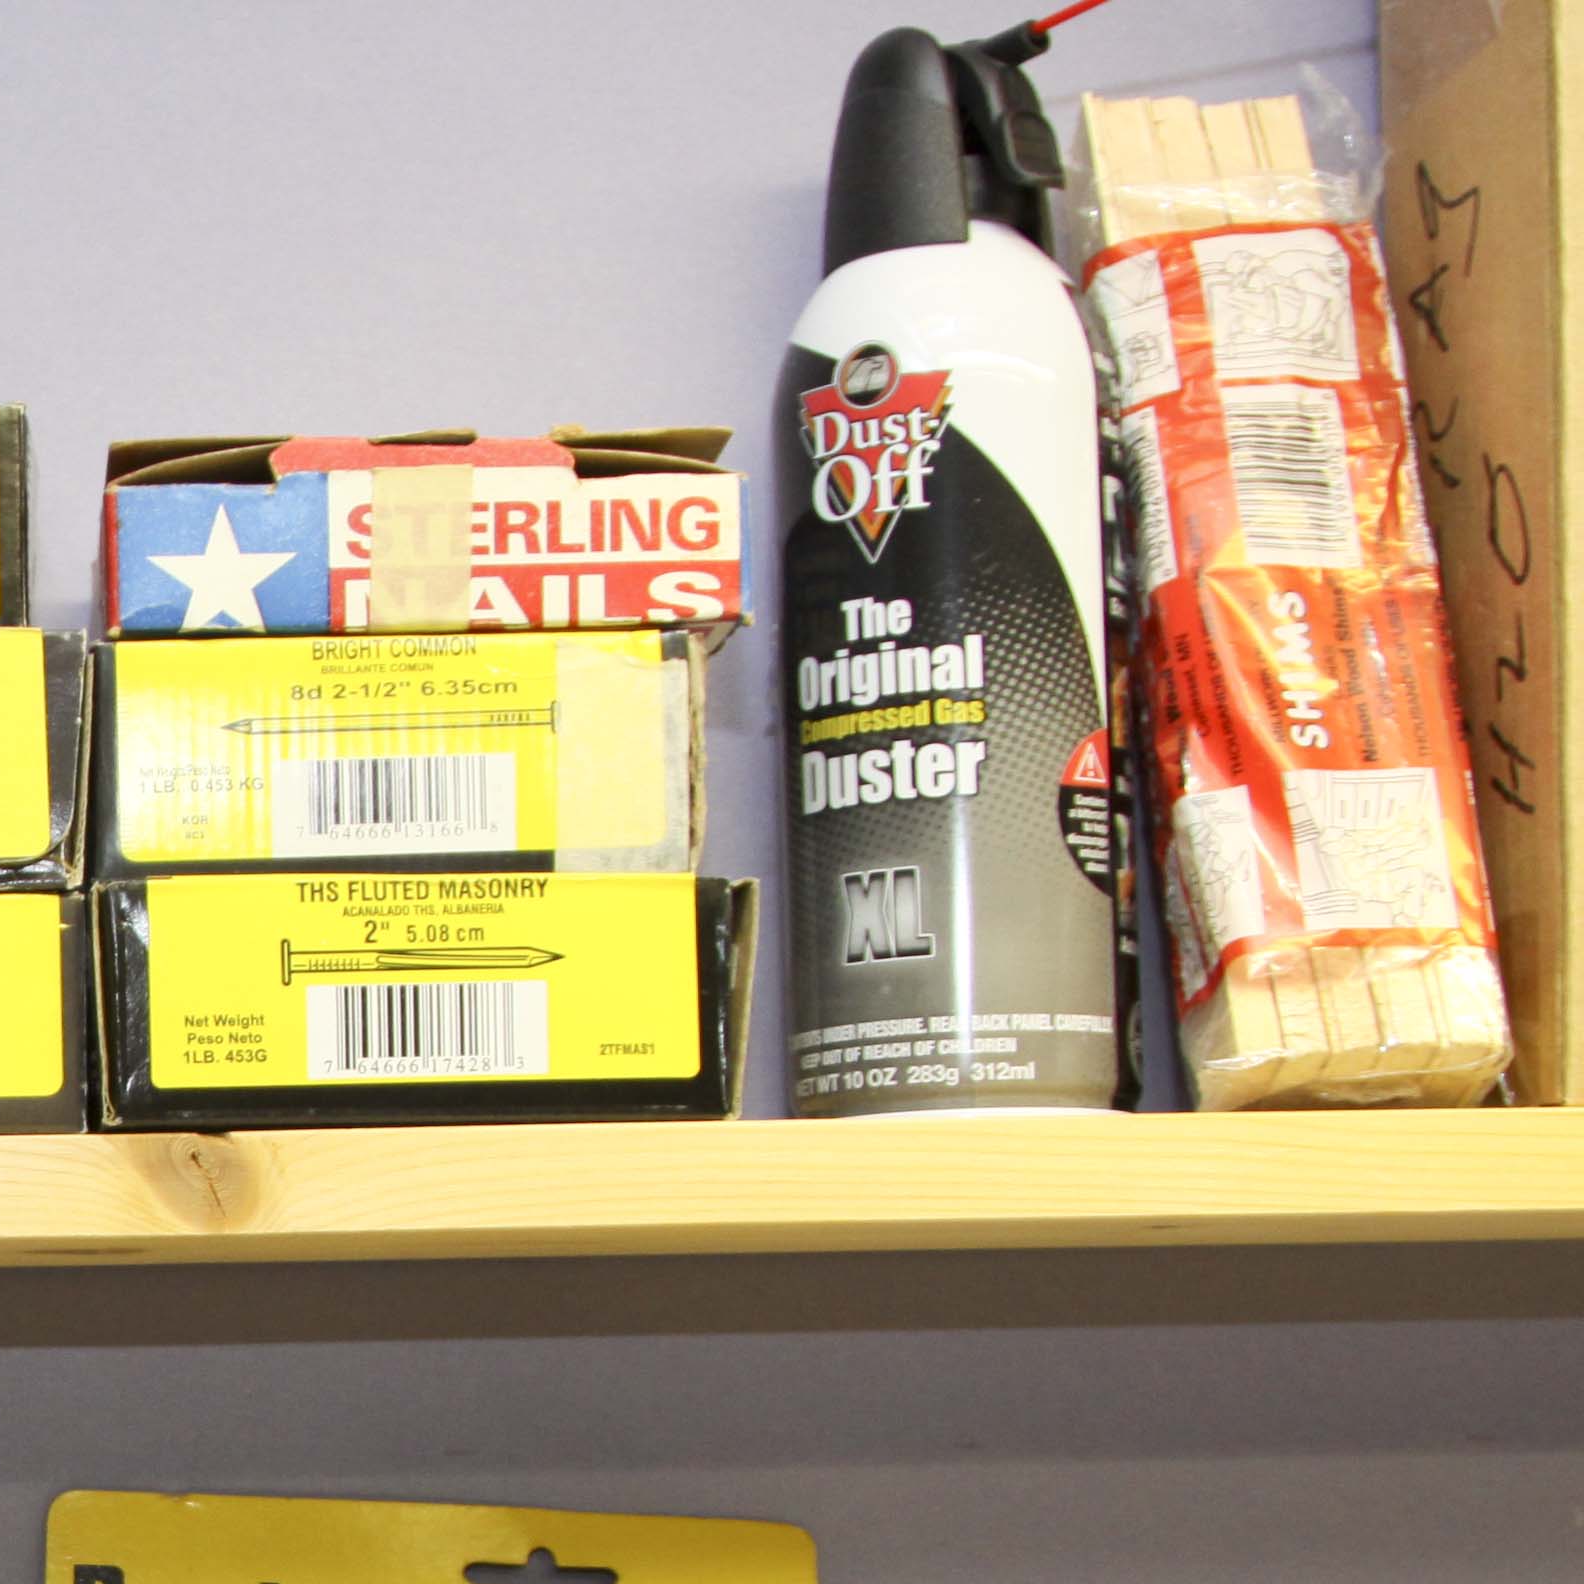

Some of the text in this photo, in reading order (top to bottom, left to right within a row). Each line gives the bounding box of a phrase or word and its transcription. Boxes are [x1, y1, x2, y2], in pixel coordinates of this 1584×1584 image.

[812, 439, 940, 522] Off
[344, 497, 721, 560] STERLING
[343, 570, 725, 629] NAILS
[840, 596, 912, 641] The
[311, 636, 478, 661] BRIGHT COMMON
[320, 662, 434, 676] BRILLANTE COMUN
[799, 633, 984, 711] Original
[1267, 590, 1330, 751] SHIMS
[1340, 647, 1367, 698] Wood
[290, 683, 322, 701] 8d
[420, 678, 518, 697] 6.35cm
[801, 698, 986, 745] Compressed Gas
[1353, 702, 1379, 765] Nelson
[190, 776, 265, 792] 0.453 KG
[802, 739, 986, 816] Duster
[296, 878, 550, 904] THS FLUTED MASONRY
[342, 906, 408, 917] ACANALADO
[842, 865, 936, 967] XL
[406, 924, 450, 944] 5.08
[456, 926, 486, 942] cm
[184, 1014, 266, 1031] Net Weight
[1011, 1014, 1053, 1030] PANEL
[186, 1031, 263, 1048] Peso Neto
[863, 1042, 911, 1061] REACH
[913, 1040, 935, 1057] OF
[224, 1048, 268, 1064] 453G
[817, 1062, 1035, 1094] WT 10 OZ 283g 312ml
